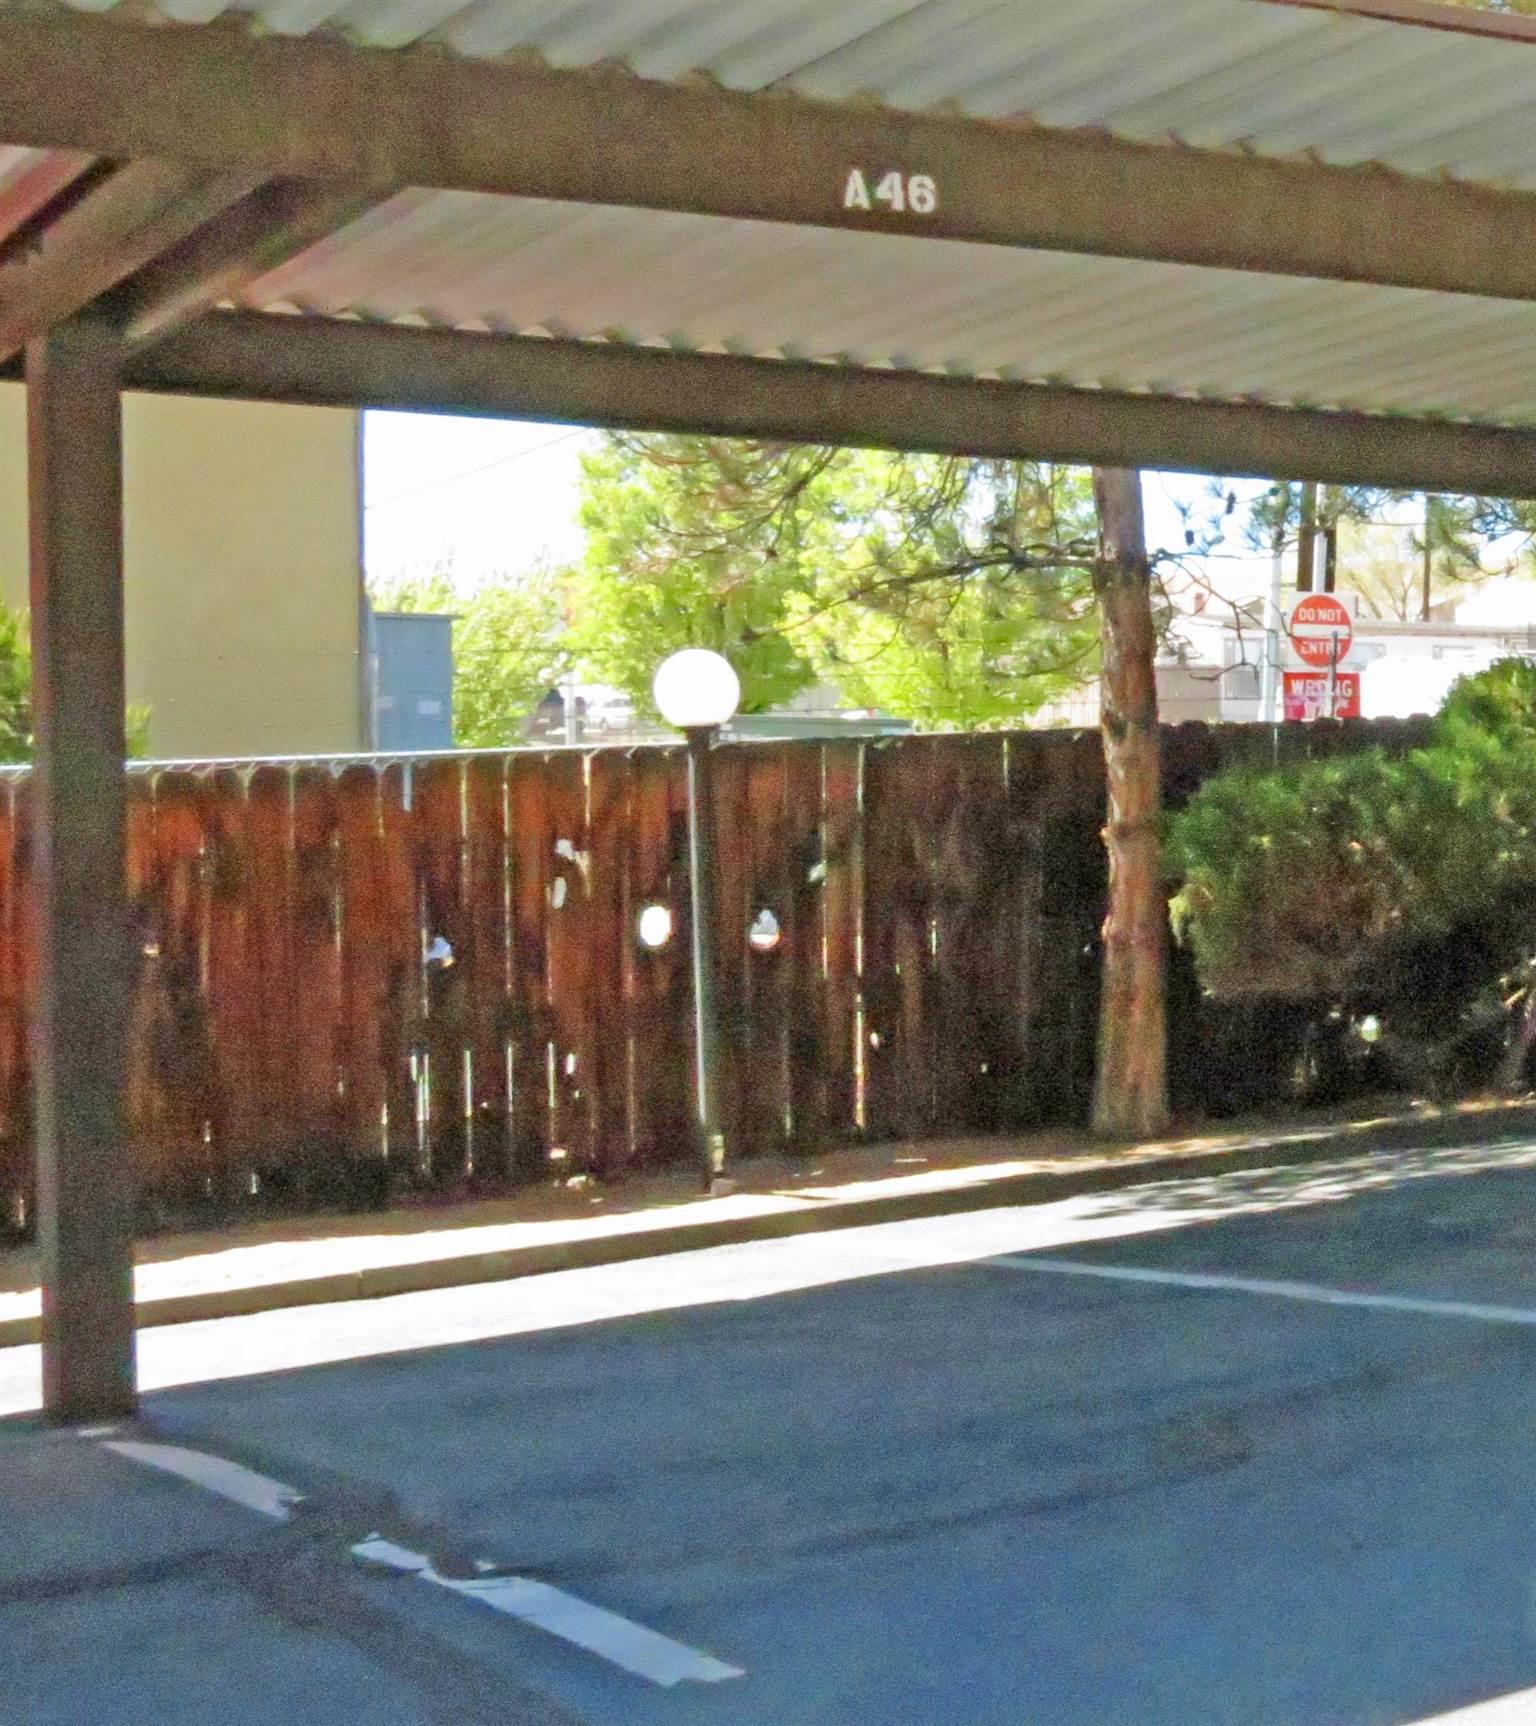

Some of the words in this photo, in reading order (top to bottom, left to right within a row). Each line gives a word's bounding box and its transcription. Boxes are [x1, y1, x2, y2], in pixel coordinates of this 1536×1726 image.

[844, 169, 936, 213] A46
[1299, 608, 1314, 621] DO
[1318, 608, 1342, 621] NOT
